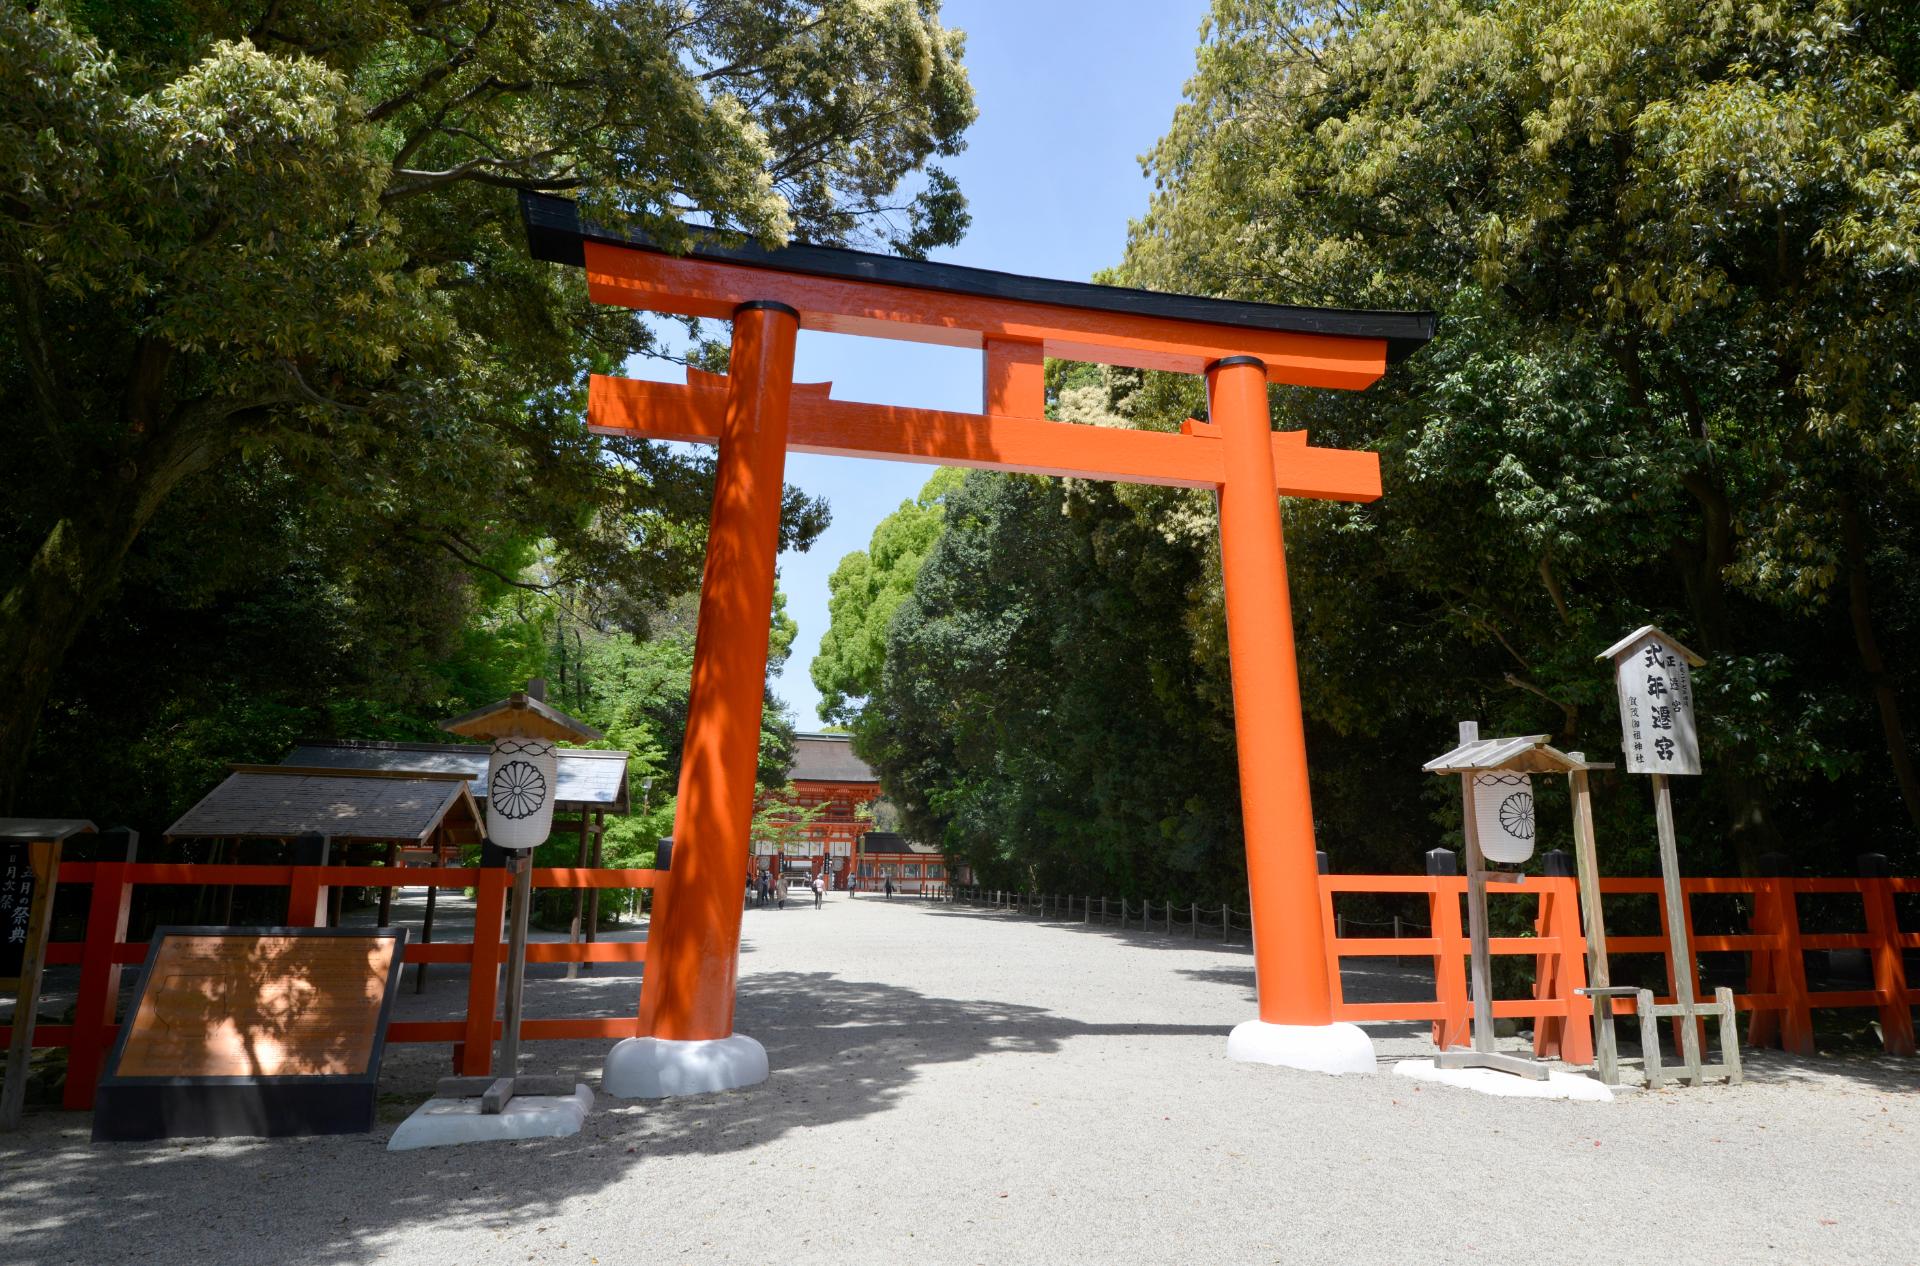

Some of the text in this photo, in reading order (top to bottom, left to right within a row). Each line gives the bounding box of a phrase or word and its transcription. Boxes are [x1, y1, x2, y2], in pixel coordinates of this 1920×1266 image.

[1628, 696, 1644, 763] 賀茂御祖神社
[1645, 643, 1675, 761] 式年遷宮
[8, 865, 35, 944] 五月の祭典
